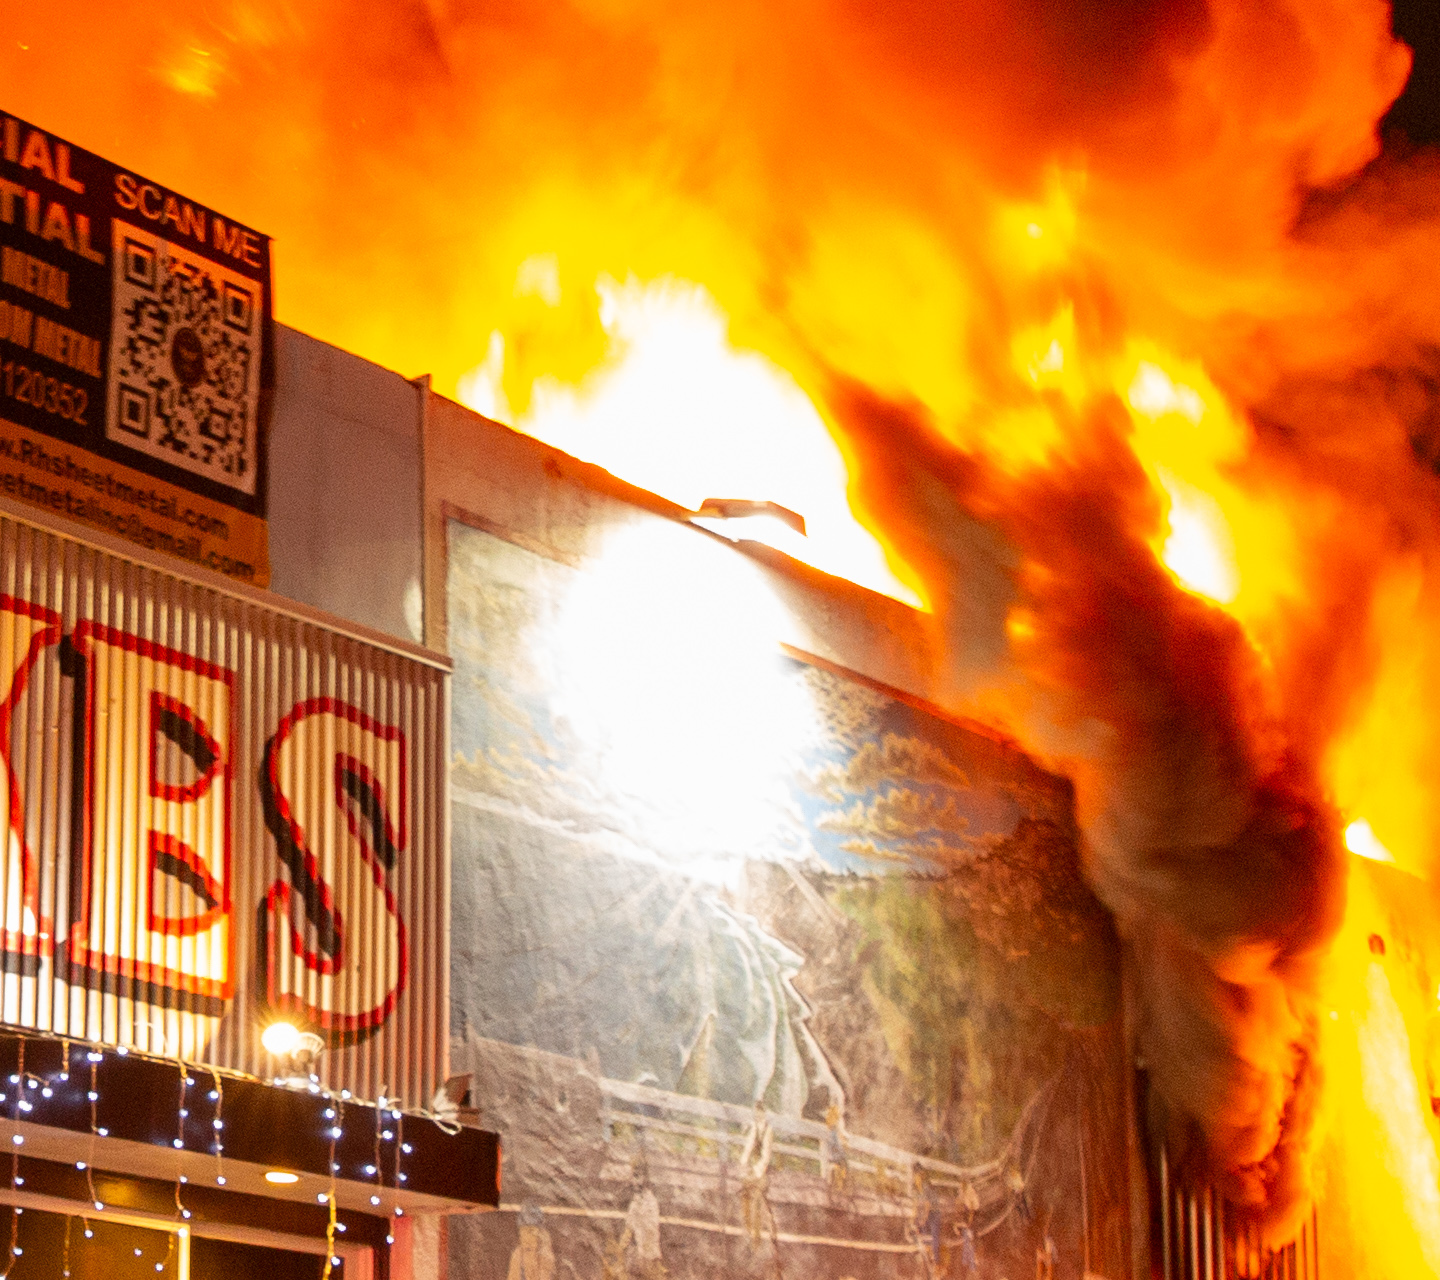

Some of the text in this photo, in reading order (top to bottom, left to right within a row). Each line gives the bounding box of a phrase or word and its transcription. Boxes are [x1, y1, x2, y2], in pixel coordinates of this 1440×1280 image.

[114, 173, 262, 269] SCAN ME
[0, 245, 70, 310] METAL
[33, 315, 102, 379] METAL
